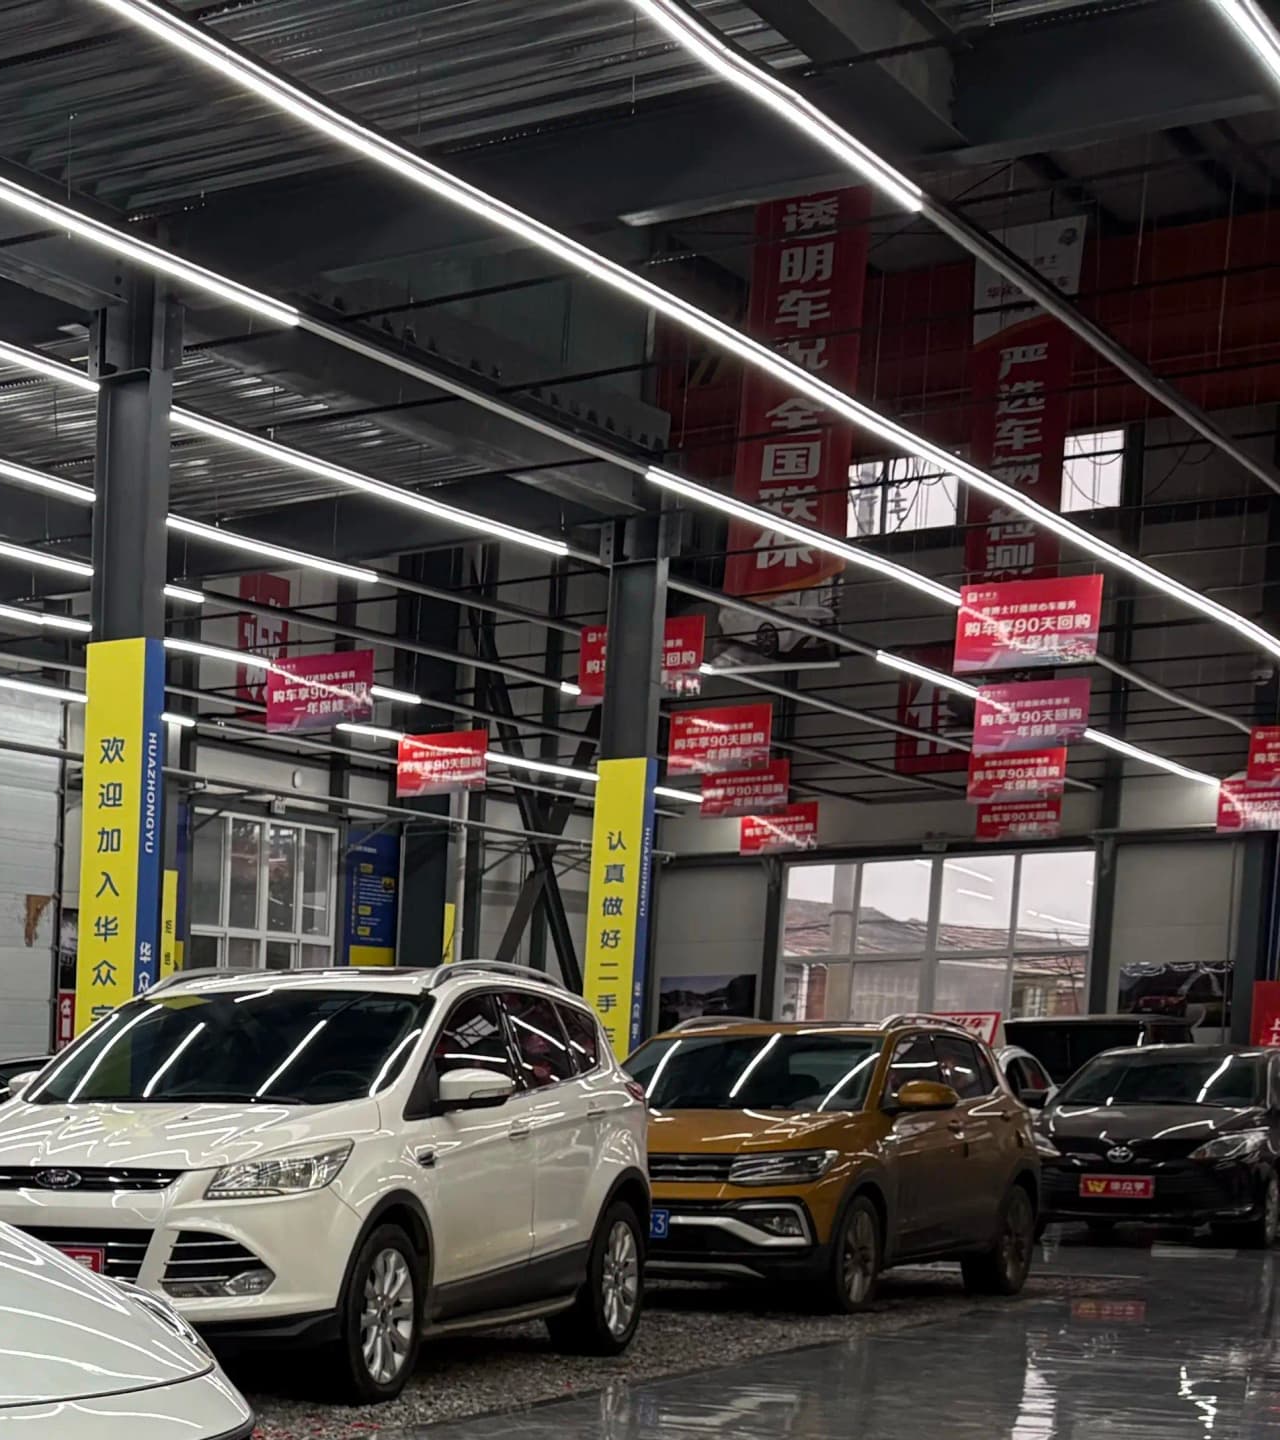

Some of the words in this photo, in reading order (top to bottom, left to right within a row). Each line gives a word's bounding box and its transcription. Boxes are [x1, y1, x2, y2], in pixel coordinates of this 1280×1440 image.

[964, 613, 1092, 639] 购车享90天回购
[980, 708, 1082, 727] 购车享90天回购
[674, 731, 765, 750] 购车享90天回购
[973, 765, 1061, 782] 购车享90天回购
[144, 732, 157, 854] HUAZHONGYU
